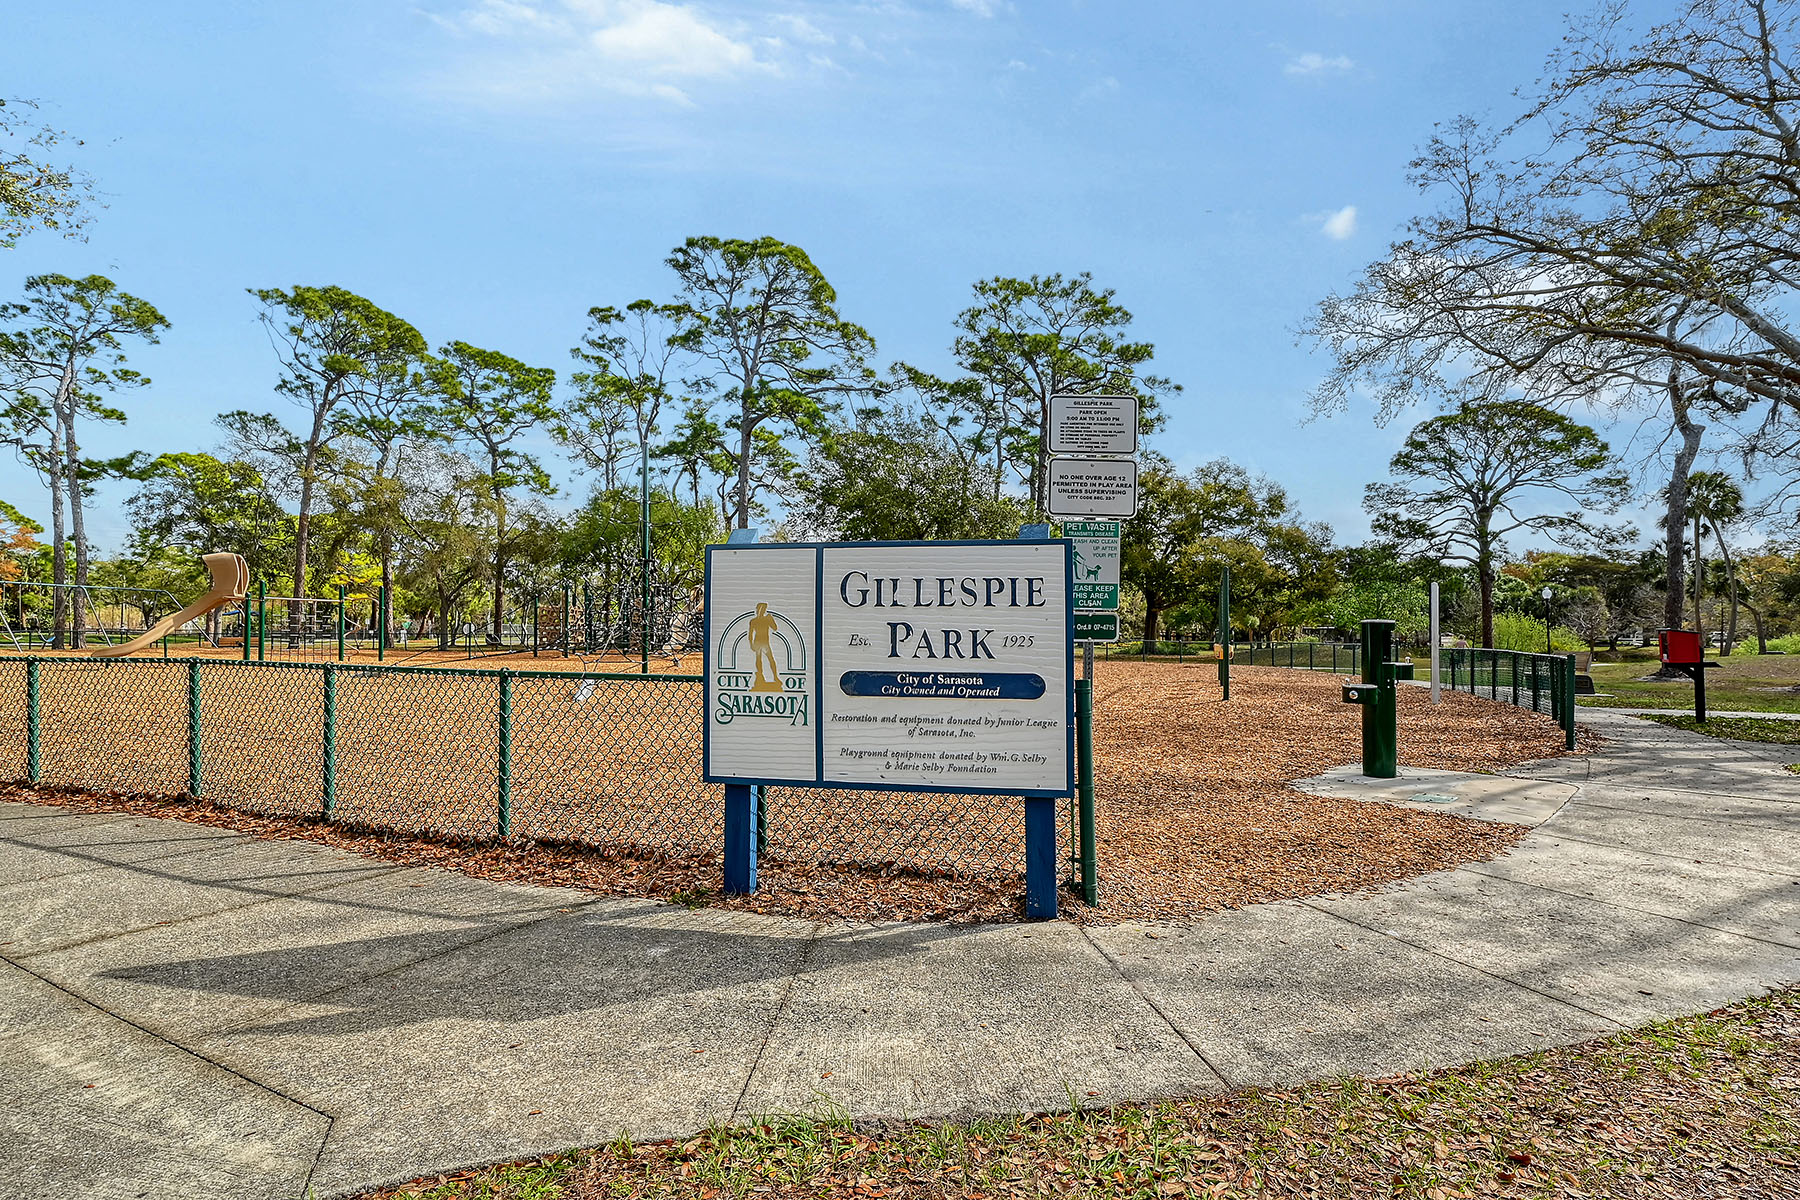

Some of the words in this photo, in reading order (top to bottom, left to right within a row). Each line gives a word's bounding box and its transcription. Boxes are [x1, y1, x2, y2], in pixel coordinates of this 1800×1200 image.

[840, 570, 1046, 607] GILLESPIE
[887, 622, 996, 659] PARK
[1002, 635, 1034, 648] 1925
[717, 676, 752, 688] CITY
[785, 678, 806, 689] OF
[897, 674, 920, 685] City
[922, 674, 933, 684] of
[937, 675, 983, 685] Sarasota
[881, 686, 900, 696] City
[903, 686, 935, 695] Owned
[937, 686, 954, 695] and
[958, 687, 1000, 698] Operated
[715, 692, 808, 726] SARASOTA
[831, 714, 877, 722] Restoration
[881, 714, 897, 723] and
[899, 715, 944, 726] equipment
[947, 716, 982, 725] donated
[984, 717, 995, 728] by
[996, 717, 1024, 728] Junior
[1026, 718, 1058, 729] League
[908, 726, 917, 738] of
[919, 728, 957, 738] Sarasota,
[960, 729, 976, 737] Inc.
[840, 748, 888, 758] Playground
[891, 750, 935, 760] equipment
[939, 751, 974, 760] donated
[976, 752, 987, 763] by
[1011, 754, 1020, 762] G.
[1022, 754, 1047, 765] Selby
[885, 761, 892, 769] &
[895, 761, 919, 770] Marie
[922, 763, 944, 773] Selby
[947, 763, 997, 773] Foundation
